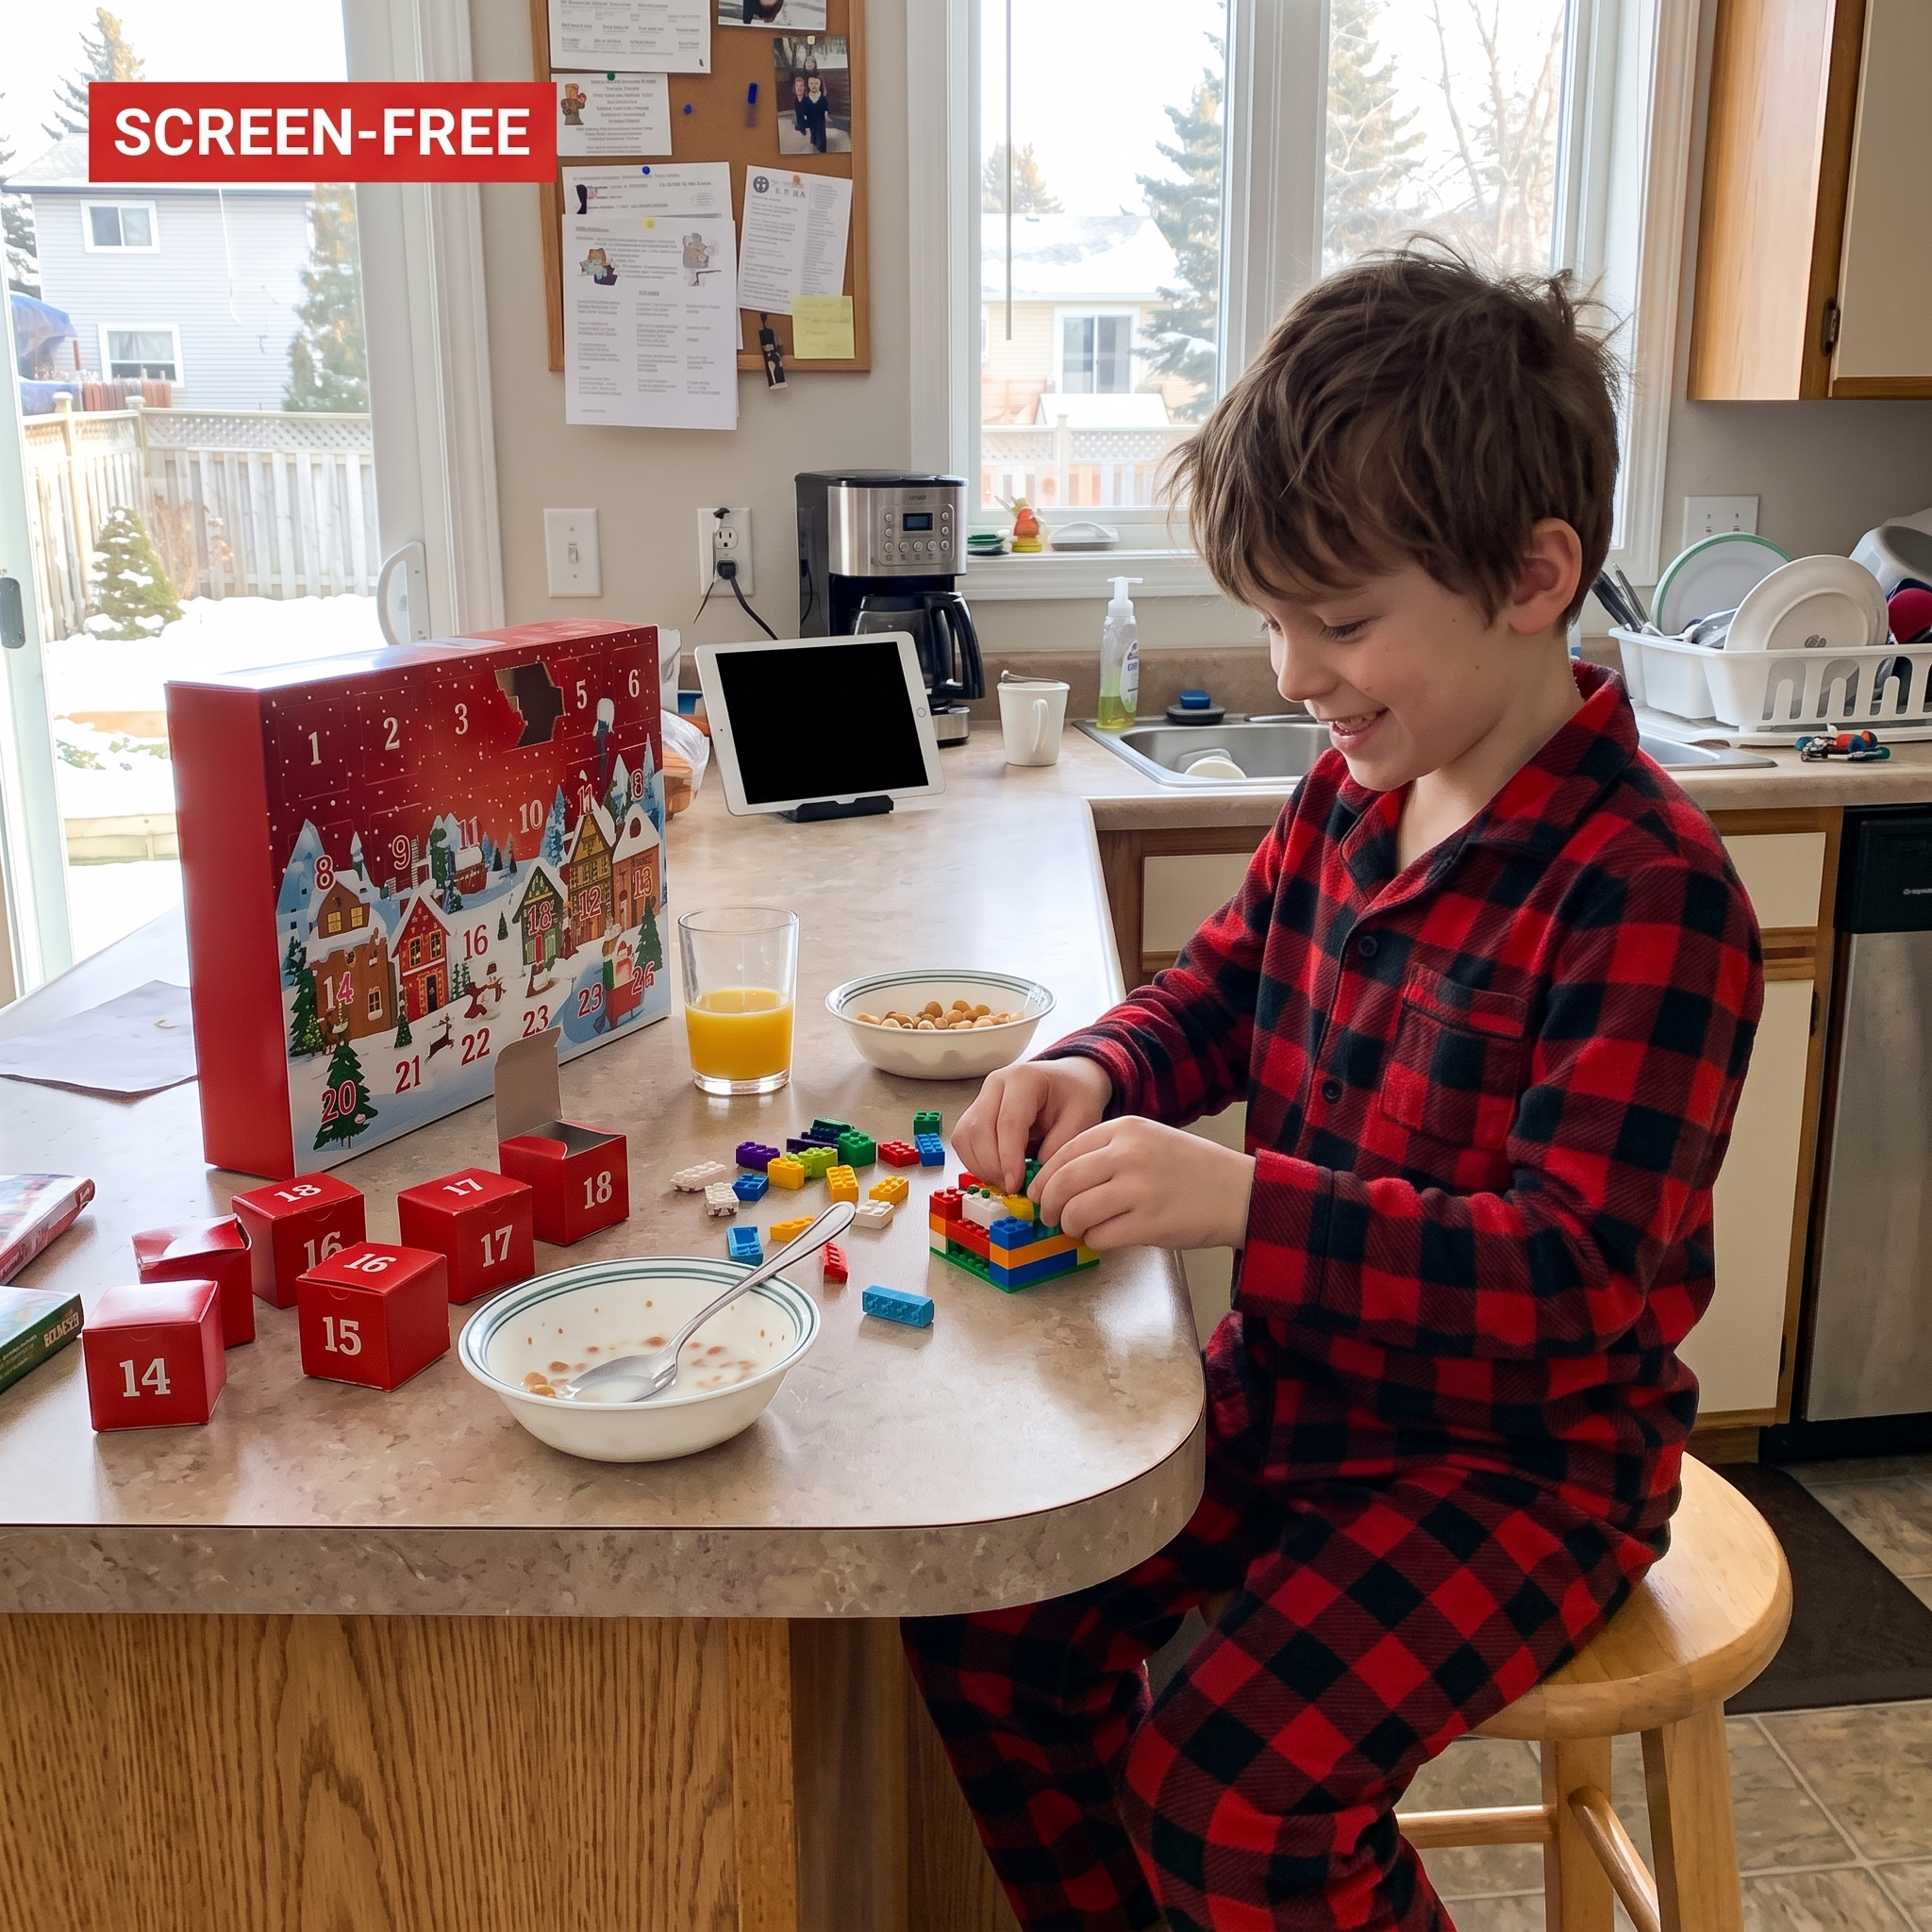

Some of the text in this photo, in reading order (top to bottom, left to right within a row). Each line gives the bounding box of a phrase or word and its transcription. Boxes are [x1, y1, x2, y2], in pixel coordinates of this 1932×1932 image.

[576, 679, 588, 709] 5
[628, 669, 641, 698] 6
[383, 717, 401, 750] 2
[455, 703, 469, 736] 3
[308, 730, 323, 766] 1
[520, 799, 543, 834] 10
[392, 834, 412, 871] 9
[314, 855, 335, 891] 8
[527, 901, 552, 936] 18
[578, 885, 602, 922] 12
[463, 924, 489, 961] 16
[324, 971, 355, 1012] 14
[577, 982, 604, 1019] 23
[522, 1005, 549, 1039] 23
[460, 1027, 491, 1066] 22
[394, 1055, 421, 1095] 21
[321, 1079, 357, 1124] 20
[274, 1184, 323, 1203] 18
[441, 1177, 484, 1198] 17
[583, 1171, 613, 1210] 18
[303, 1230, 342, 1272] 16
[342, 1253, 397, 1273] 16
[480, 1224, 514, 1269] 17
[322, 1315, 362, 1357] 15
[119, 1357, 172, 1398] 14
